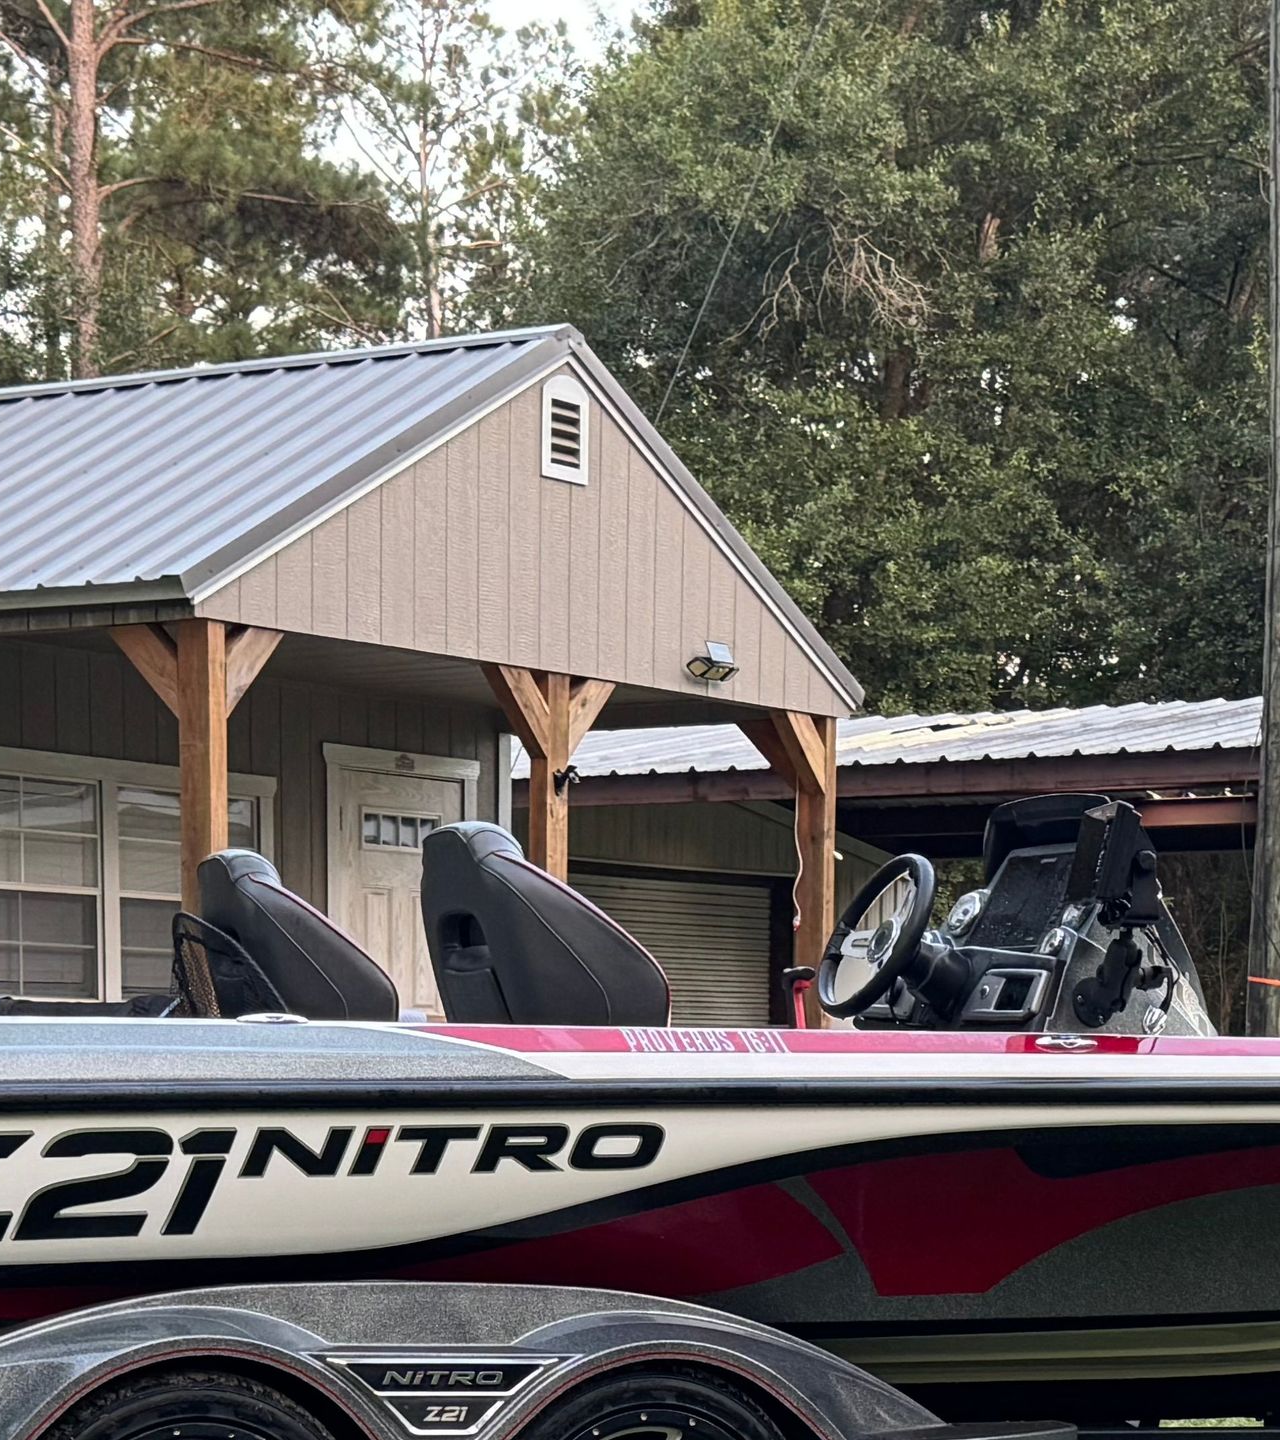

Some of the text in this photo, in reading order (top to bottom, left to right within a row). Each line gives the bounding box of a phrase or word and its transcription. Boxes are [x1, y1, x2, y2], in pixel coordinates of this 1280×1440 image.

[620, 1028, 793, 1053] PROVERBS 16:11
[423, 1405, 469, 1422] Z21
